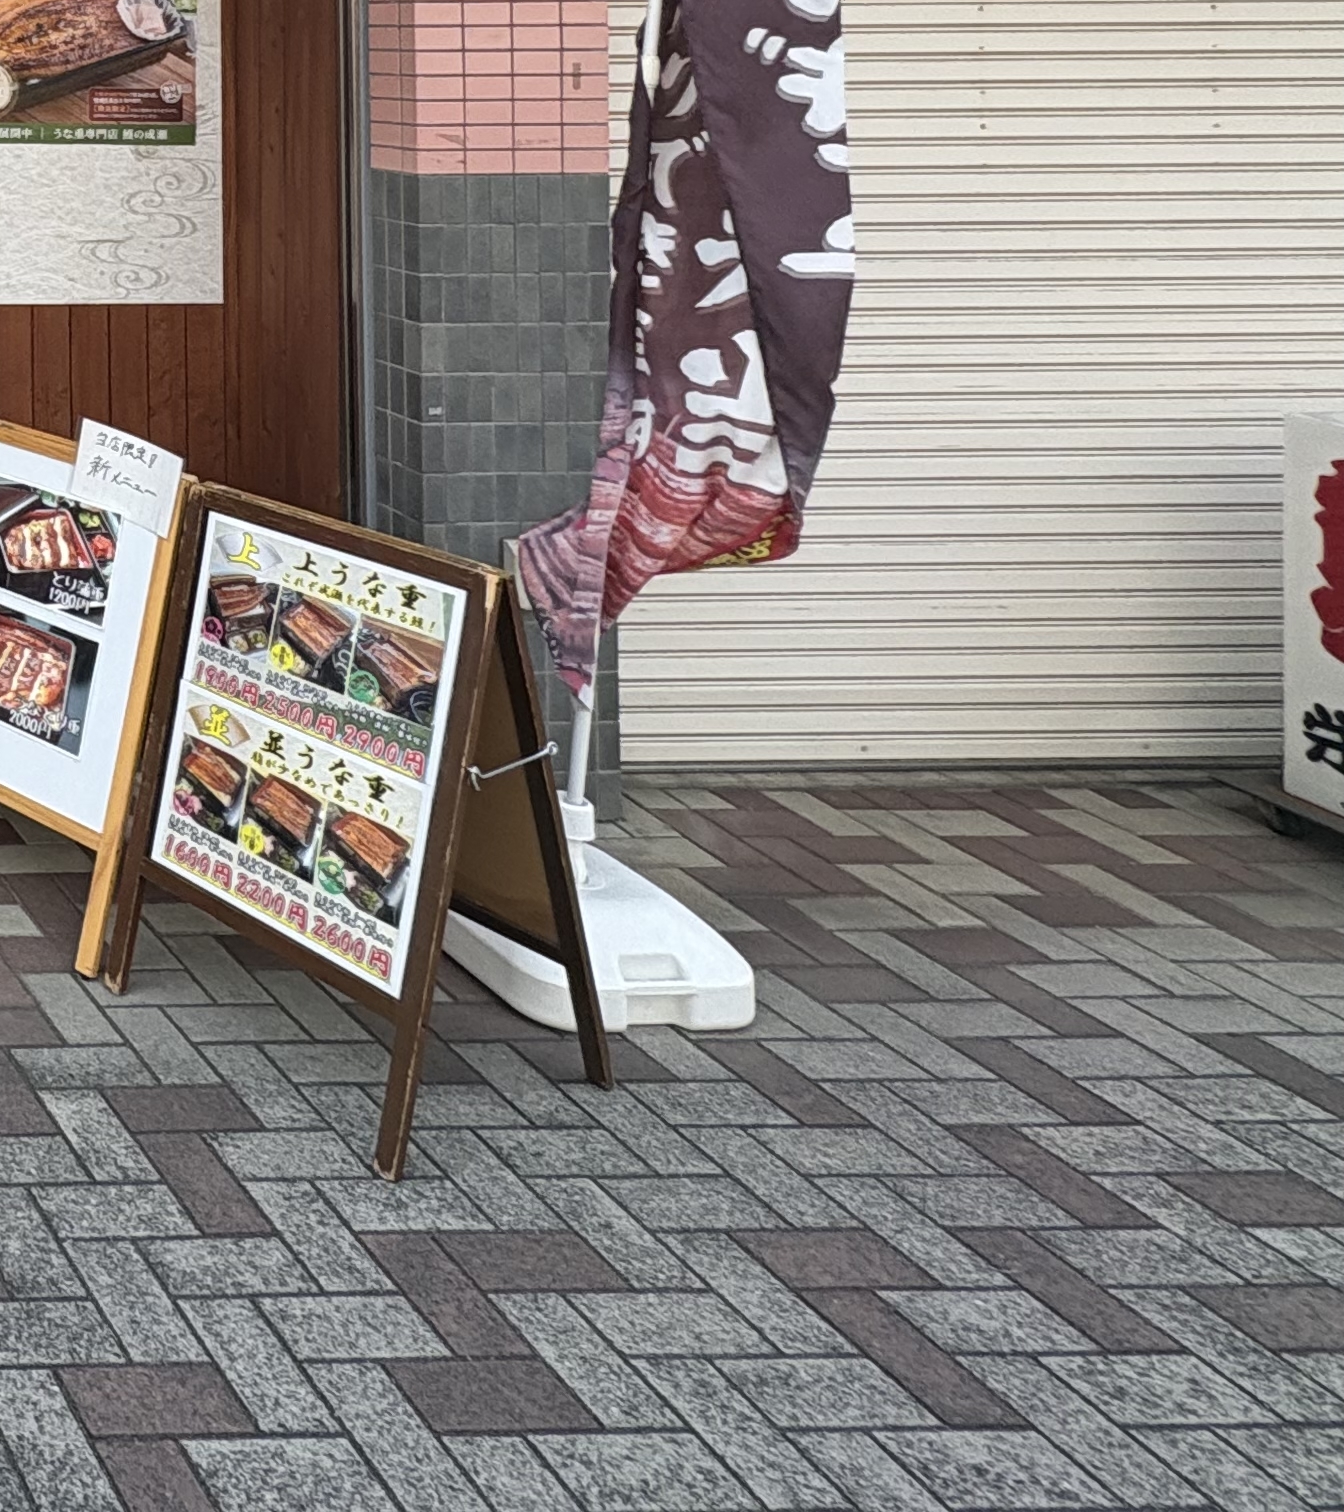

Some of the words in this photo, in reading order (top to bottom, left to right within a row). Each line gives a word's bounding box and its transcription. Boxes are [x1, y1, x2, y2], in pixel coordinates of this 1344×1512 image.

[86, 454, 158, 498] 新メニュー
[227, 532, 261, 571] 上
[48, 585, 91, 616] 1200円
[293, 551, 428, 612] 上うな重
[8, 708, 53, 740] 2000円
[203, 704, 231, 747] 並
[261, 689, 338, 741] 2500円
[342, 724, 426, 779] 2900円
[259, 729, 397, 805] 並うな重
[163, 833, 233, 890] 1600円
[234, 872, 310, 933] 2200円
[312, 914, 394, 980] 2600円
